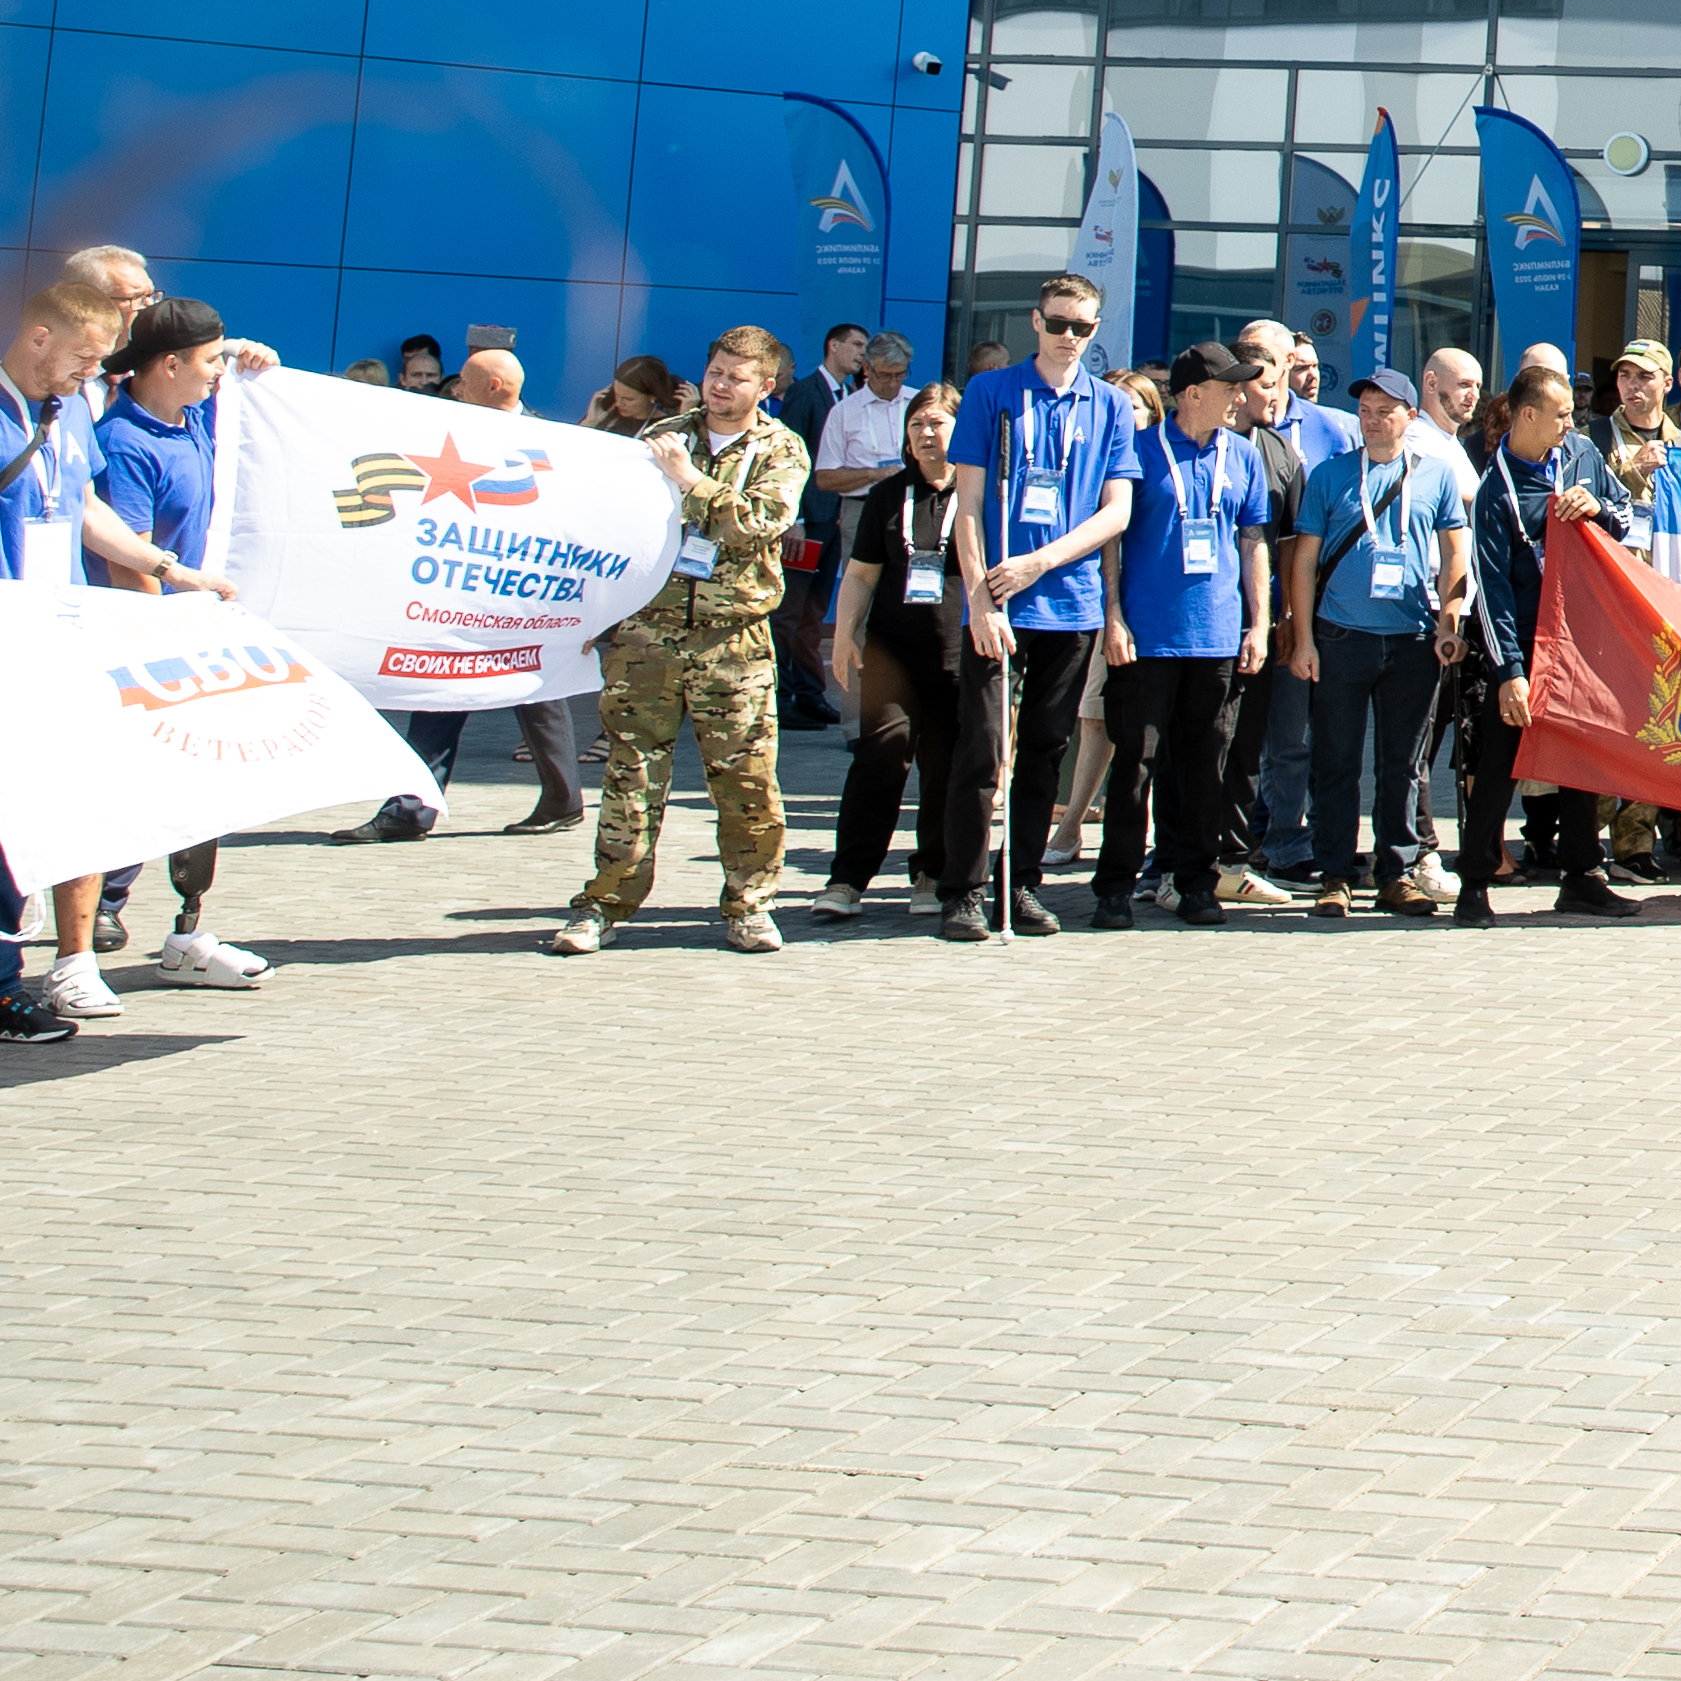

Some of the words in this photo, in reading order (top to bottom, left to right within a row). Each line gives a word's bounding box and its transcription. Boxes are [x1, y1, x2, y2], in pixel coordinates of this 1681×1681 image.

[416, 518, 632, 580] ЗАЩИТНИКИ
[411, 556, 587, 602] ОТЕЧЕСТВА
[405, 601, 524, 630] Смоленская
[523, 616, 583, 630] область
[387, 652, 452, 675] СВОИХ
[453, 655, 475, 675] НЕ
[475, 649, 539, 673] БРОСАЕМ
[152, 692, 332, 763] ВЕТЕРАНОВ
